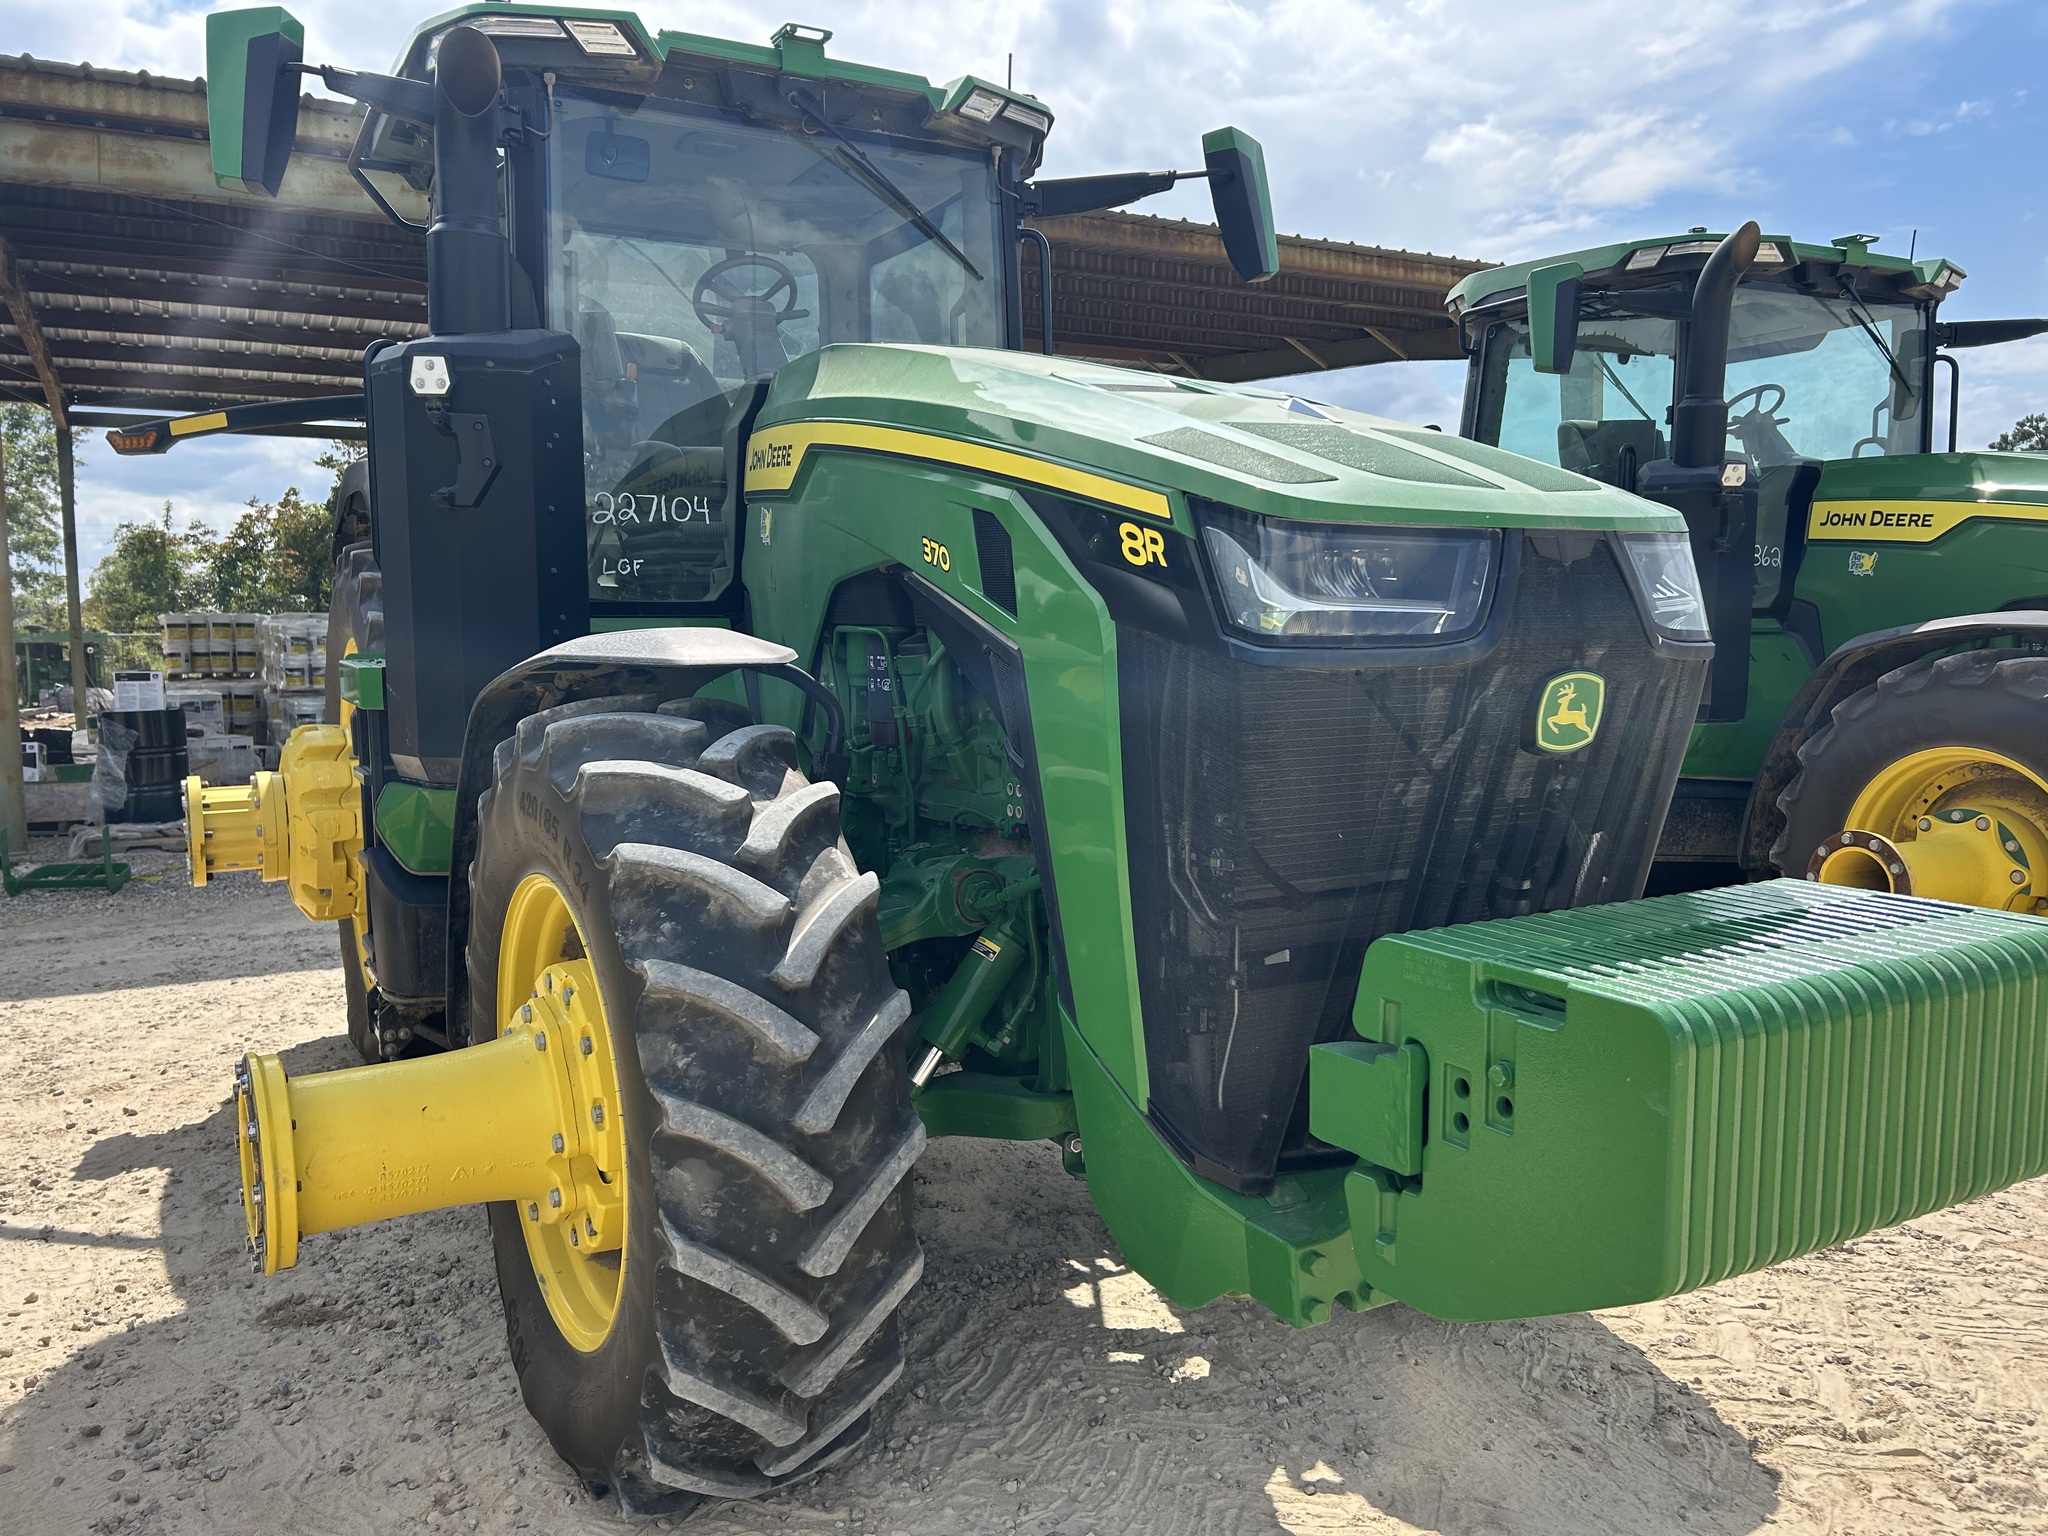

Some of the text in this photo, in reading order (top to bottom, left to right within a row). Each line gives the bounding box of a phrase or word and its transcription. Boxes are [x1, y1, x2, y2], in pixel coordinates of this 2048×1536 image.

[750, 443, 793, 471] JOHN DEERE
[592, 492, 711, 526] 227104
[1820, 510, 1934, 528] JOHN DEERE
[921, 535, 951, 572] 370
[1118, 521, 1169, 568] 8R
[1754, 544, 1781, 568] 362
[520, 791, 559, 842] 420/85
[334, 1190, 355, 1201] USA
